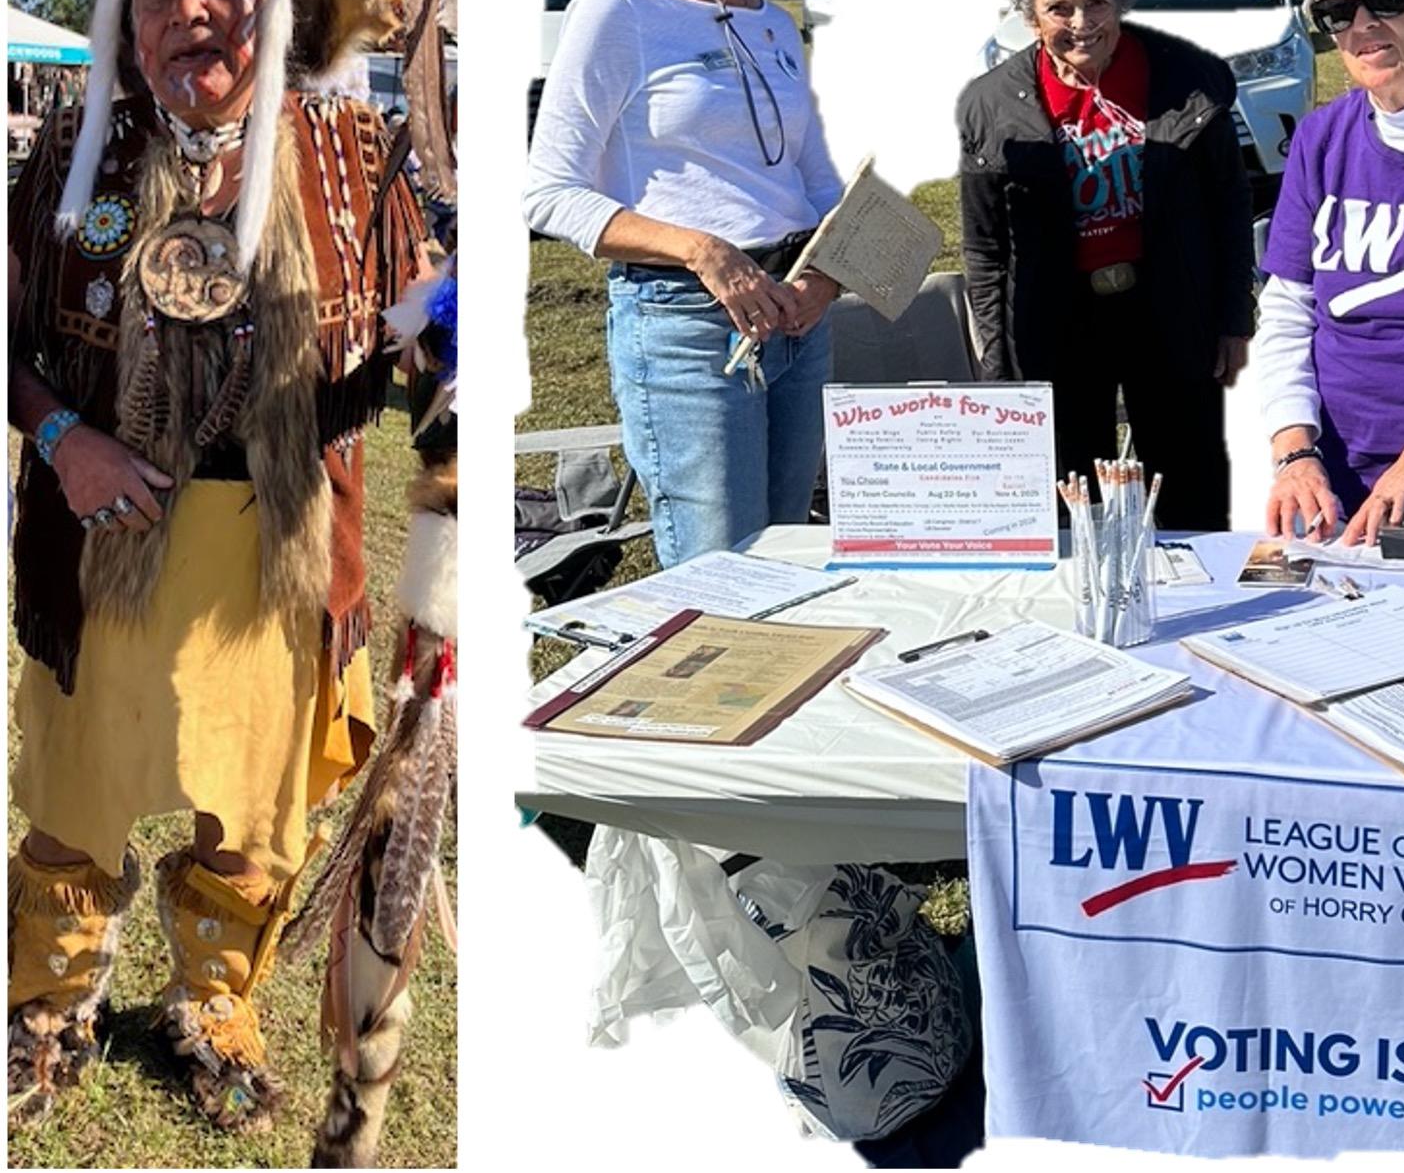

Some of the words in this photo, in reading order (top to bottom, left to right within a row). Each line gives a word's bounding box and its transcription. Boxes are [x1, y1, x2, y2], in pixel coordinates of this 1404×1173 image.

[832, 406, 883, 427] Who
[889, 391, 953, 416] works
[959, 395, 991, 416] for
[994, 406, 1047, 427] you?
[873, 461, 900, 472] State
[901, 461, 909, 471] &
[911, 461, 938, 472] Local
[940, 460, 1002, 472] Government
[840, 490, 855, 499] City
[928, 490, 943, 500] Aug
[896, 540, 918, 551] Your
[918, 540, 940, 550] Vote
[965, 540, 992, 550] Voice
[1049, 788, 1205, 872] LWV
[1244, 815, 1381, 856] LEAGUE
[1243, 851, 1386, 892] WOMEN
[1269, 897, 1296, 916] OF
[1302, 896, 1394, 925] HORRY
[1145, 1016, 1361, 1077] VOTING
[1196, 1084, 1309, 1114] people
